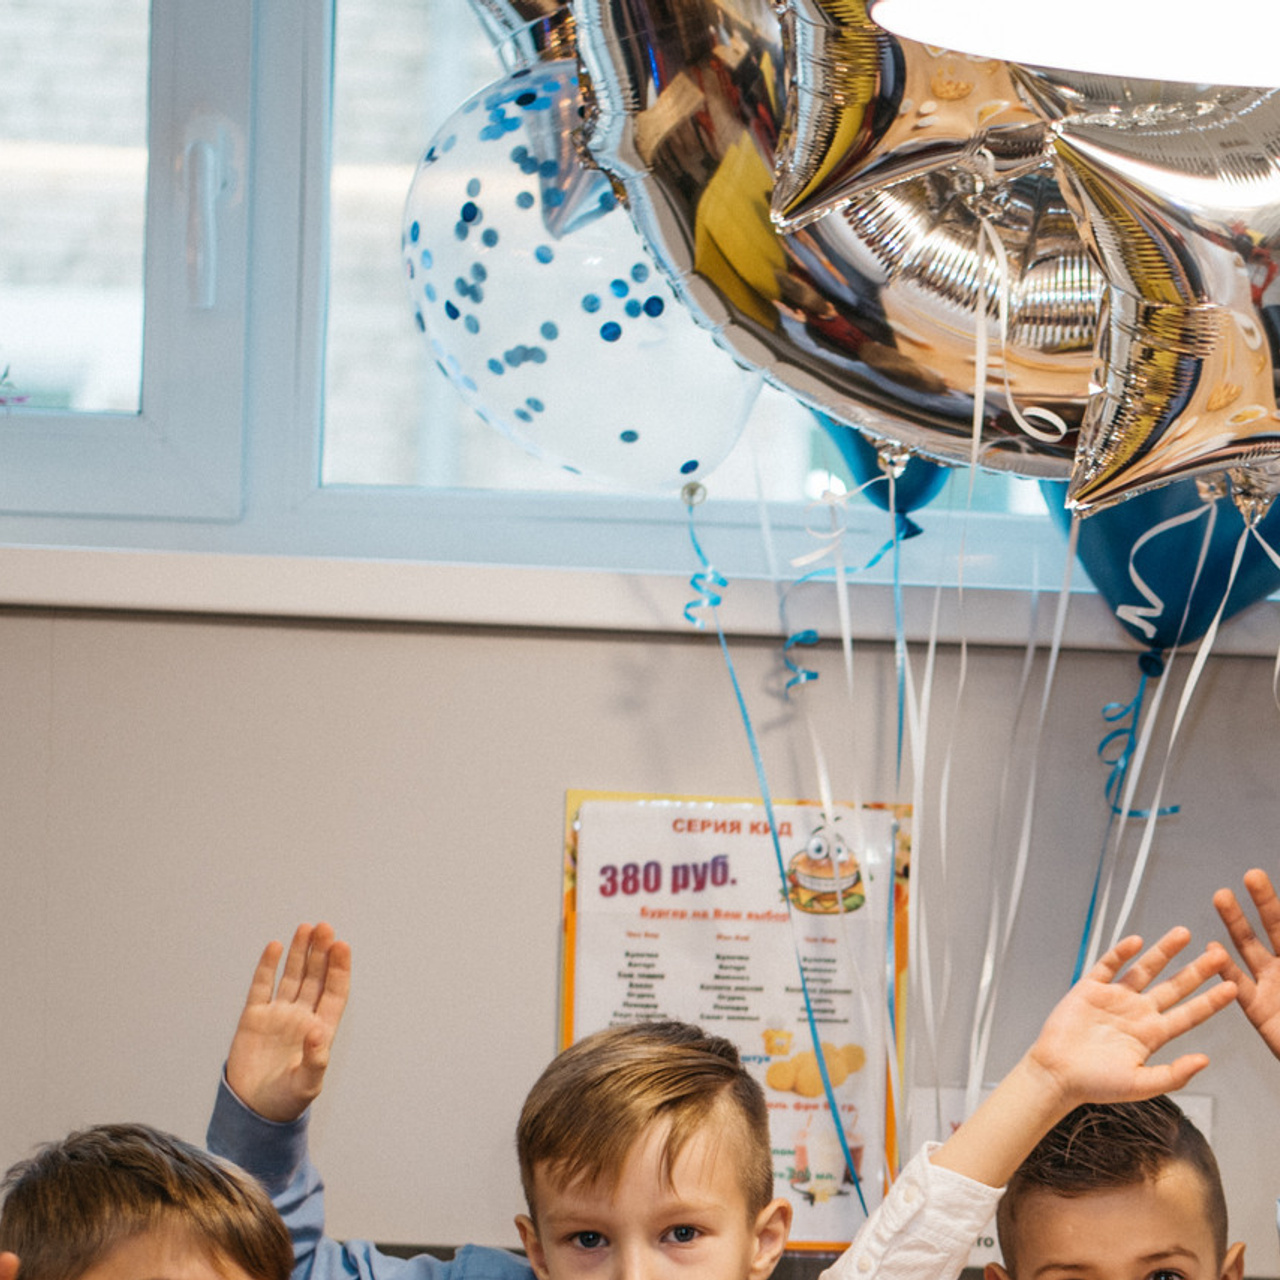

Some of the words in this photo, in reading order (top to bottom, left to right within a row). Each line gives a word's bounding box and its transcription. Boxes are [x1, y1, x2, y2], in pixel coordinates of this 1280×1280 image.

[672, 818, 742, 834] СЕРИЯ
[750, 821, 793, 837] КИД
[599, 860, 662, 898] 380
[671, 854, 737, 895] руб.
